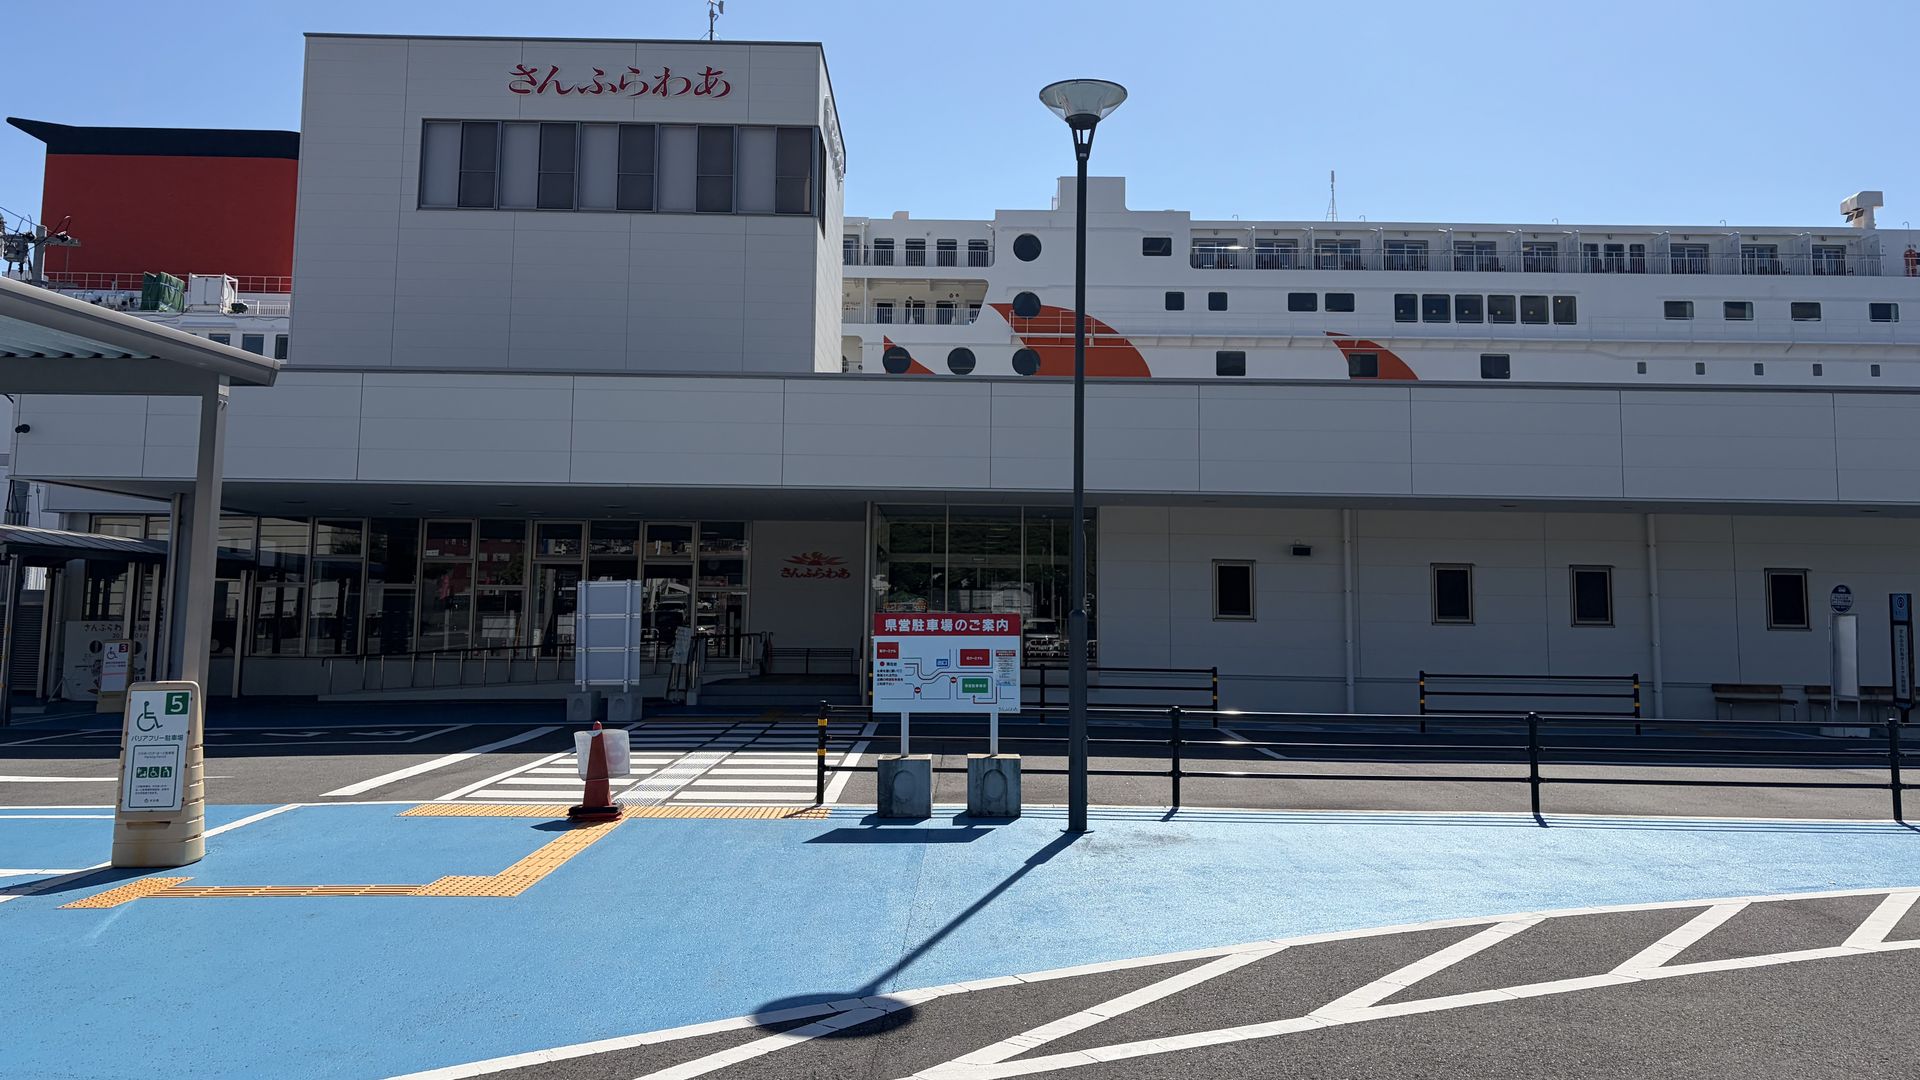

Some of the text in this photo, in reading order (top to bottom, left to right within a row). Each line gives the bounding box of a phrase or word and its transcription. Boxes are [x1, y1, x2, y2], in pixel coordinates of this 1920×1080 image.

[509, 64, 731, 98] さんふらわあ
[780, 567, 850, 579] さんふらわあ
[885, 618, 1009, 632] 県営駐車場のご案内
[120, 644, 127, 652] 3
[170, 695, 183, 712] 5
[131, 734, 183, 742] バリアフリー駐車場
